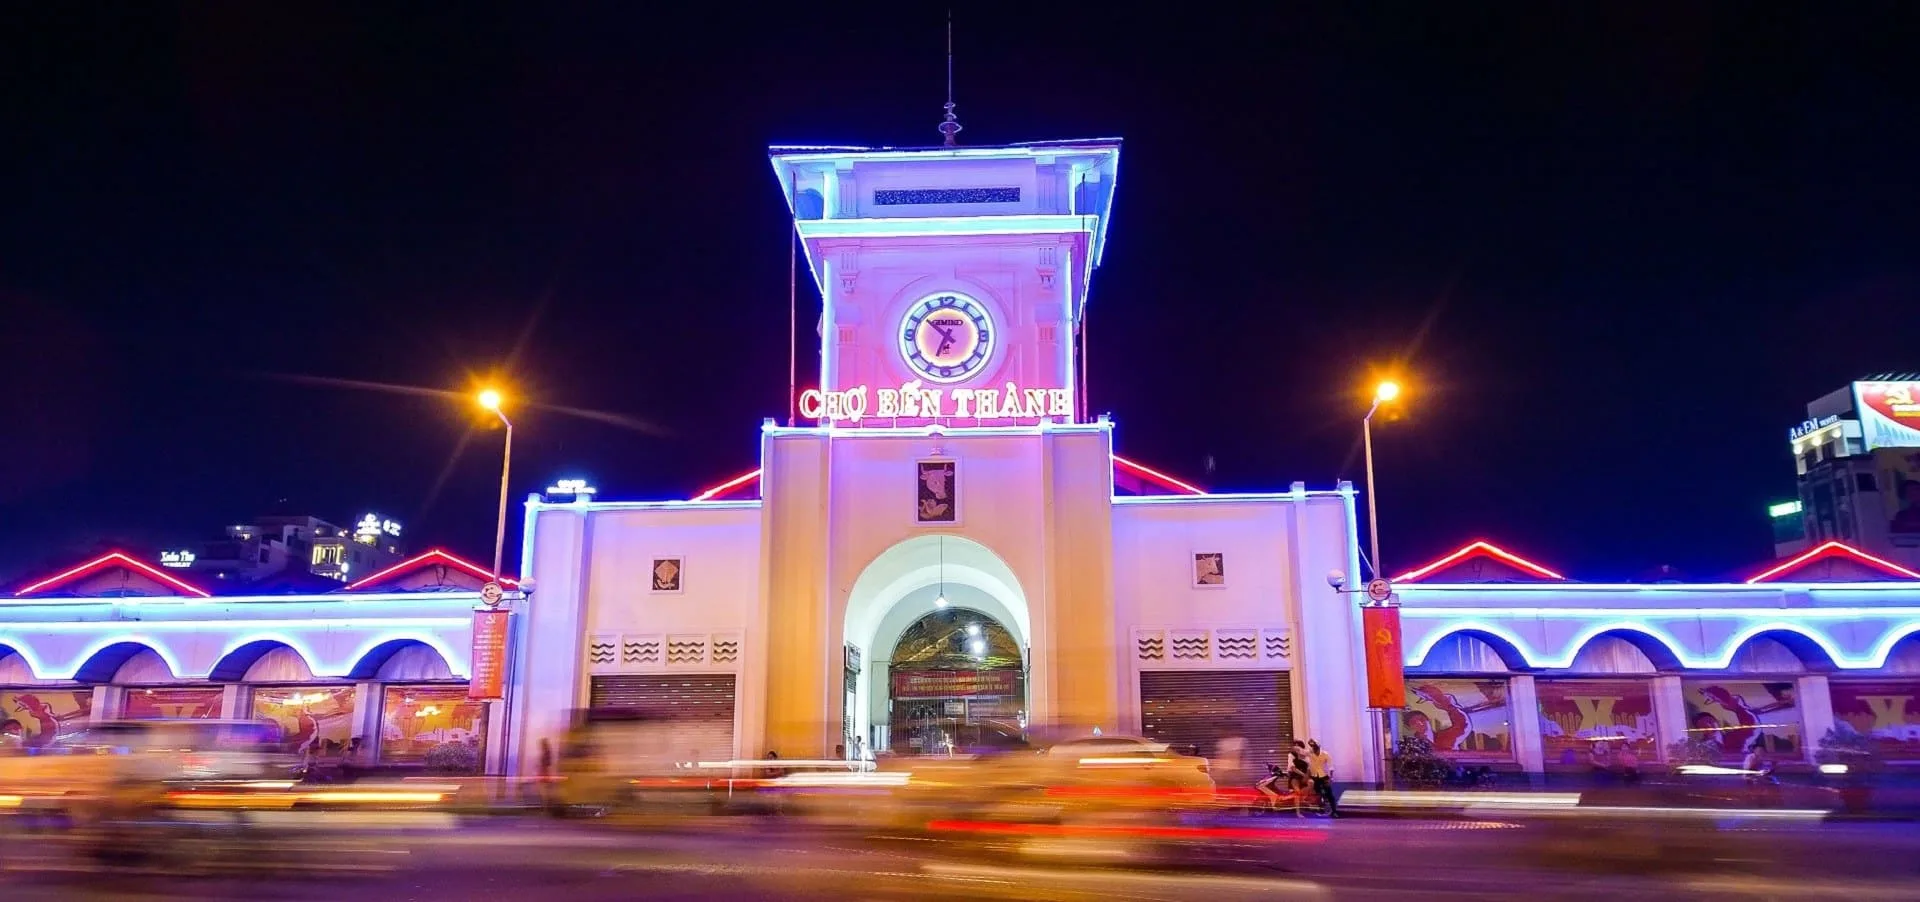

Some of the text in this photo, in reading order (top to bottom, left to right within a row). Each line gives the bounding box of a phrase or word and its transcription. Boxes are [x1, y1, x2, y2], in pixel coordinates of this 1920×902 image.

[939, 296, 956, 307] 12
[904, 329, 915, 342] 9
[799, 381, 1073, 422] CHỢ BẾN THÀNH
